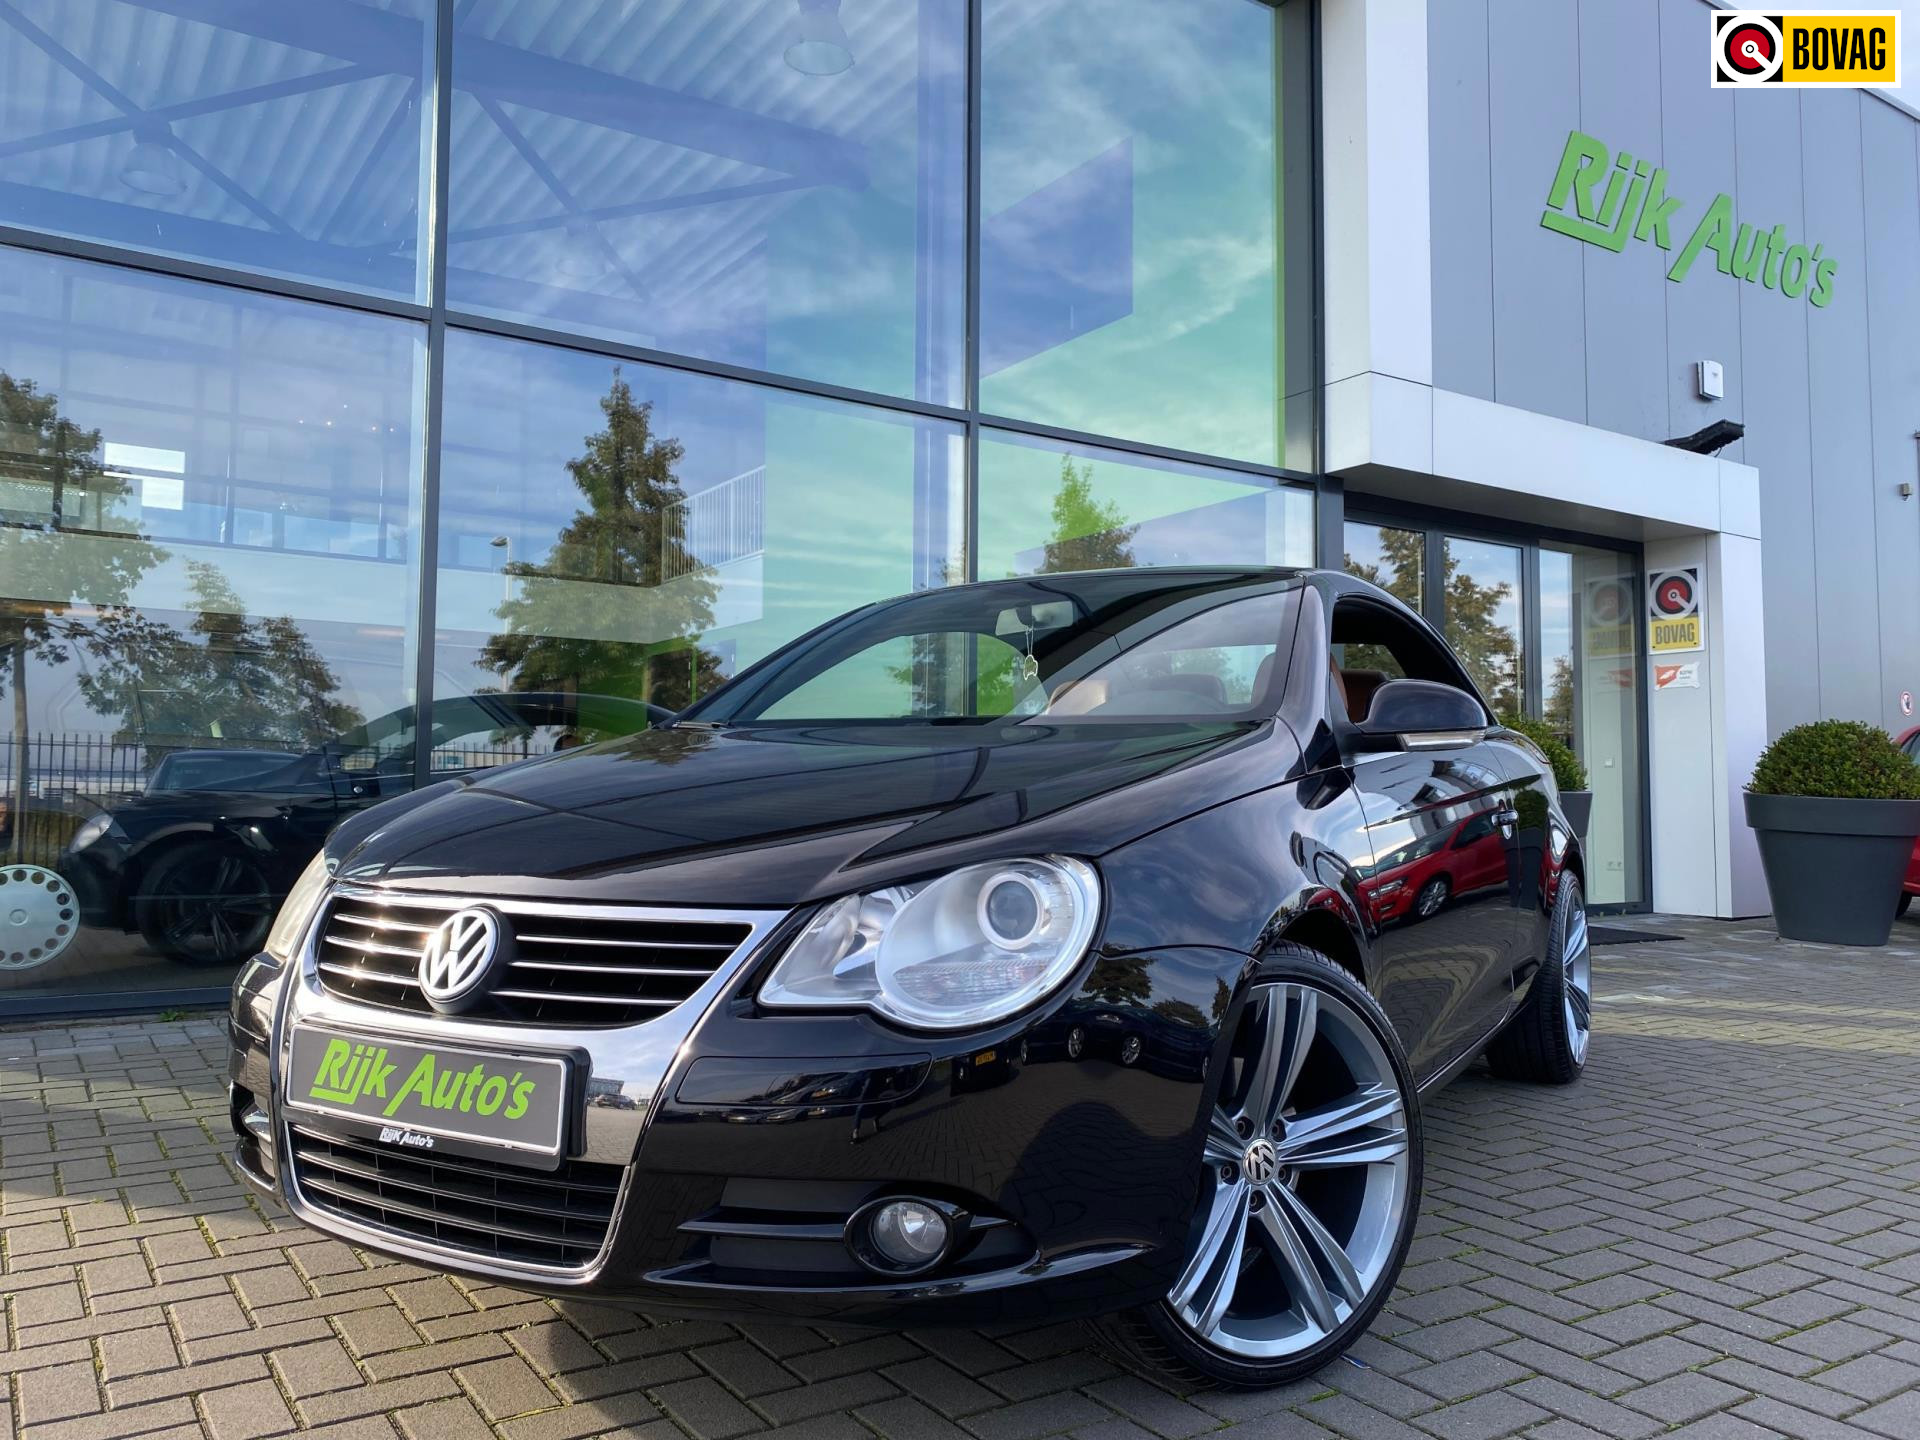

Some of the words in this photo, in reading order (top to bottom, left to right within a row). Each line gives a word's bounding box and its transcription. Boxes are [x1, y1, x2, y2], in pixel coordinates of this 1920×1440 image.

[1540, 130, 1684, 253] Rijk
[1667, 193, 1838, 308] Auto's
[1655, 622, 1695, 645] BOVAG
[420, 907, 497, 999] VW
[309, 1039, 398, 1105] Rijk
[383, 1054, 536, 1120] Auto's
[399, 1132, 434, 1148] Auto's
